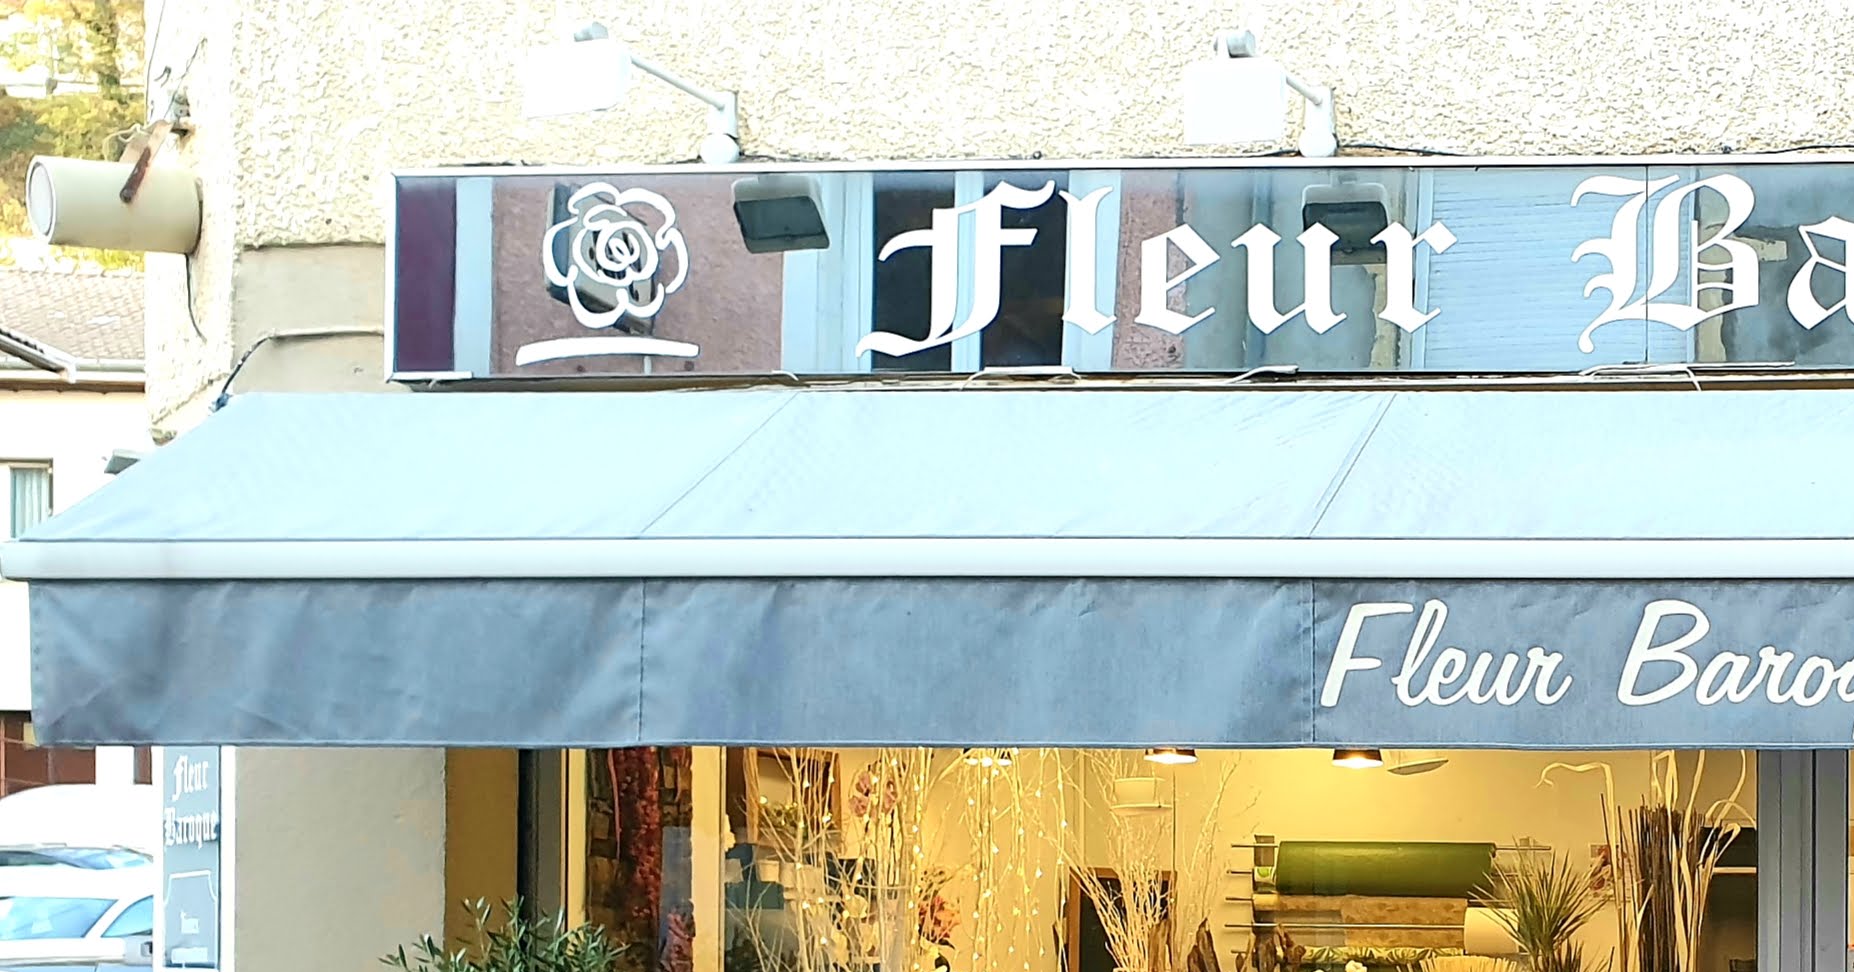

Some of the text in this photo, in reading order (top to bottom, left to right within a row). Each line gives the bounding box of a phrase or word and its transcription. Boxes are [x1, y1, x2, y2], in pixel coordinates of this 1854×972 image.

[856, 179, 1458, 359] Fleur
[1320, 599, 1573, 707] Fleur
[171, 755, 209, 802] Fleur
[164, 807, 218, 850] Baroque
